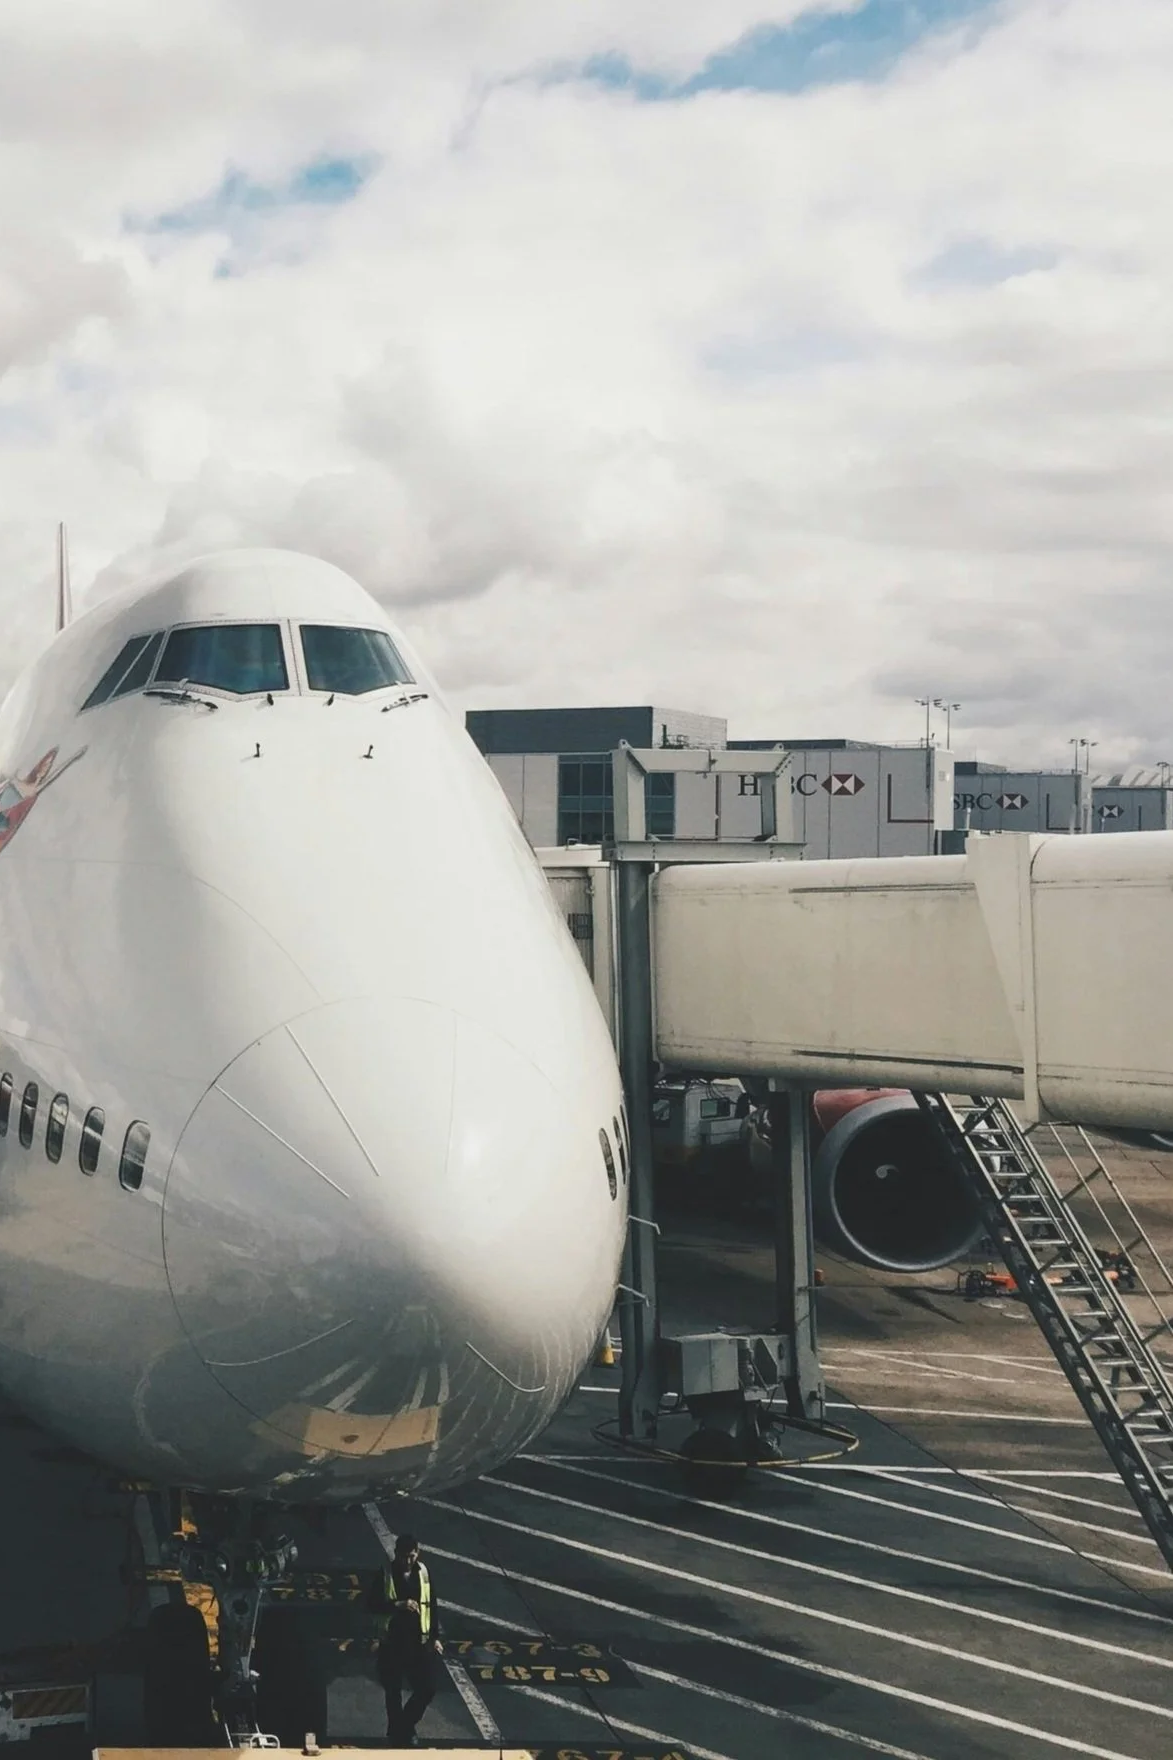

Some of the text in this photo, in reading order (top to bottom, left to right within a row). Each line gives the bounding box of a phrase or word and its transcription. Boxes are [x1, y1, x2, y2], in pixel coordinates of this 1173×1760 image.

[737, 773, 818, 796] HC
[953, 793, 993, 810] SBC
[469, 1664, 611, 1683] 787-9
